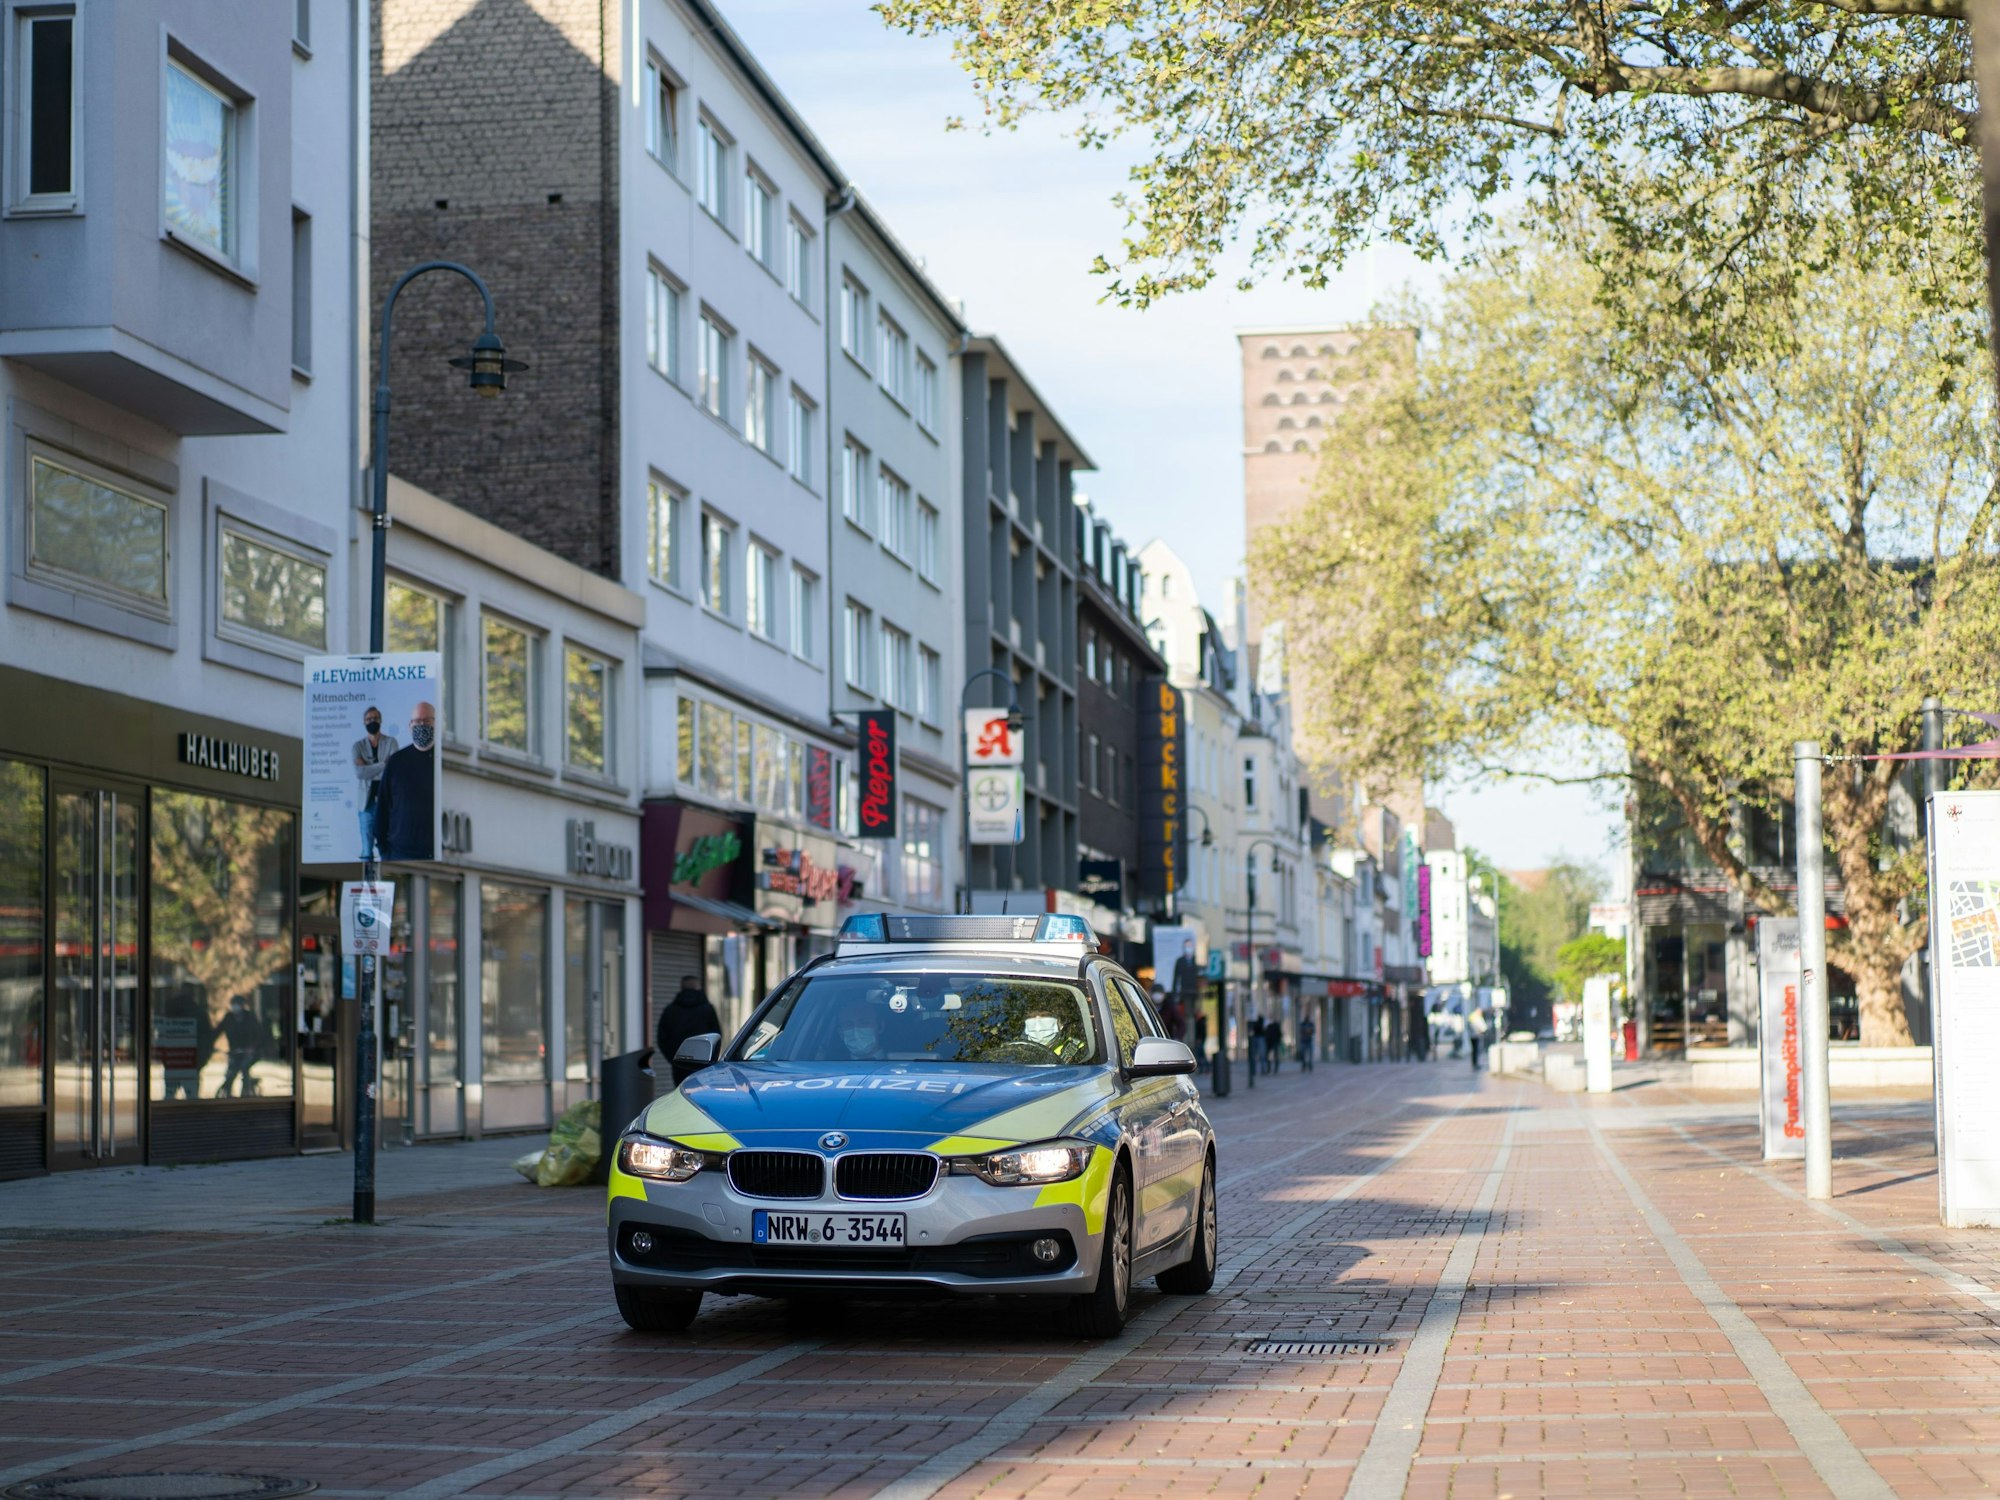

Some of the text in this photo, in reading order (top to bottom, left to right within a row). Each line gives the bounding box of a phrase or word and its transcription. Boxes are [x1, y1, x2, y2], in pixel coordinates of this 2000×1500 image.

[312, 665, 426, 684] #LEVmitMASKE
[312, 692, 366, 703] Mitmachen
[186, 731, 280, 781] HALLHUBER
[861, 718, 893, 827] Pieper
[1782, 985, 1805, 1138] Funkenplätzchen
[759, 1078, 966, 1094] POLIZEI
[767, 1216, 809, 1241] NRW
[822, 1217, 903, 1242] 6-3544
